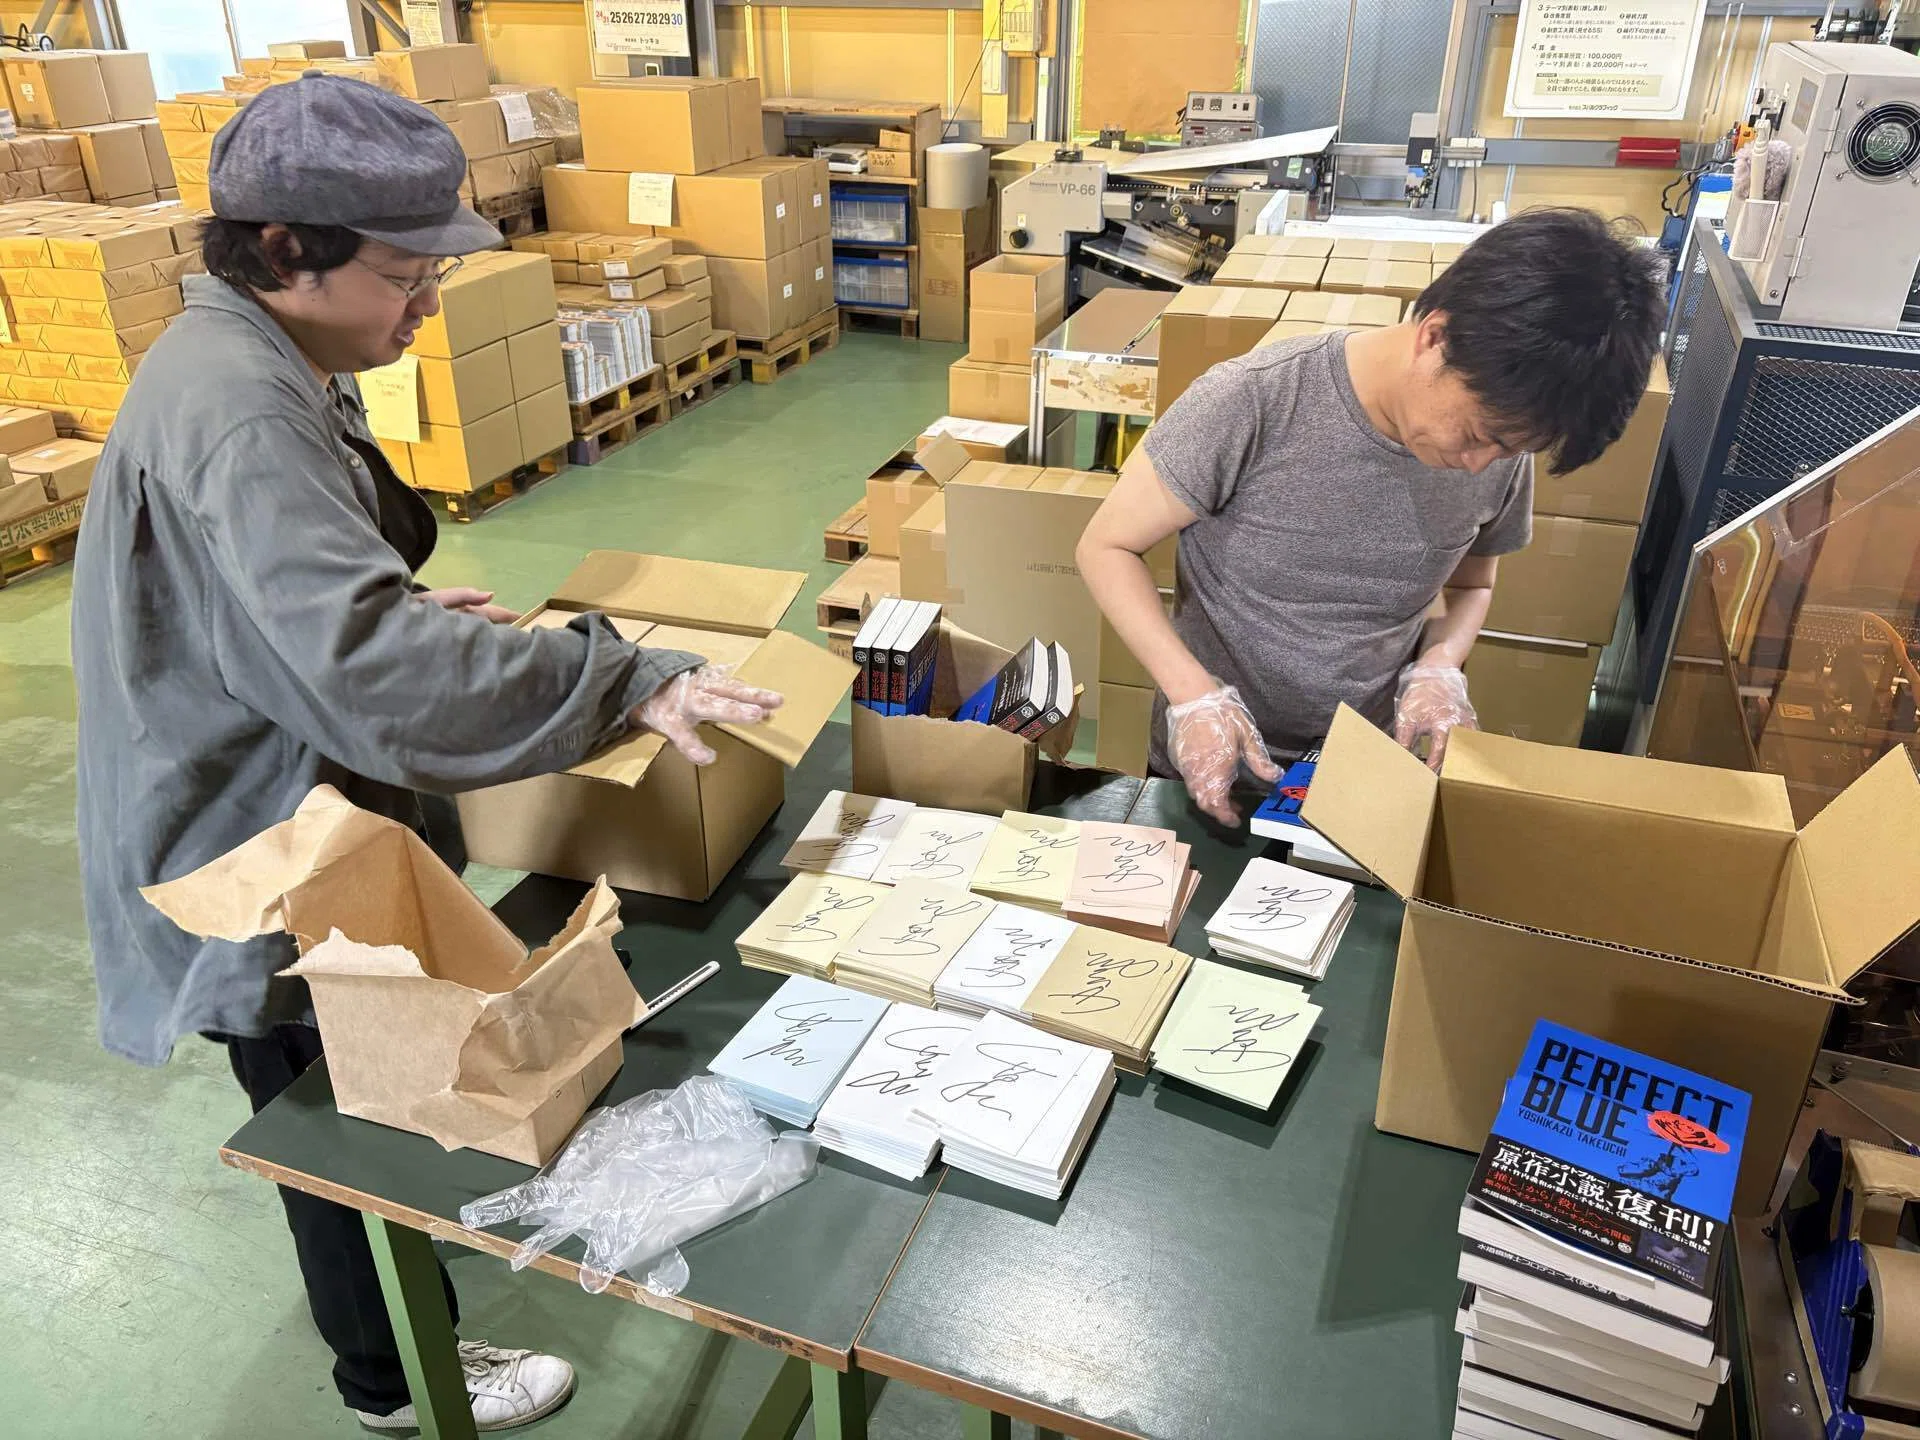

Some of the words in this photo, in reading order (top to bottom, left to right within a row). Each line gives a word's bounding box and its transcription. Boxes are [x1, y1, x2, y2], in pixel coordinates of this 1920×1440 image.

[609, 11, 621, 24] 25
[621, 12, 633, 24] 26
[634, 12, 645, 25] 27
[646, 12, 658, 25] 28
[659, 13, 670, 25] 29
[671, 13, 683, 26] 30
[1059, 183, 1096, 196] VP-66
[1519, 1071, 1638, 1147] BLUE
[1535, 1036, 1735, 1137] PERFECT
[1517, 1107, 1575, 1140] YOSHIKAZU
[1575, 1130, 1629, 1157] TAKEUCHI
